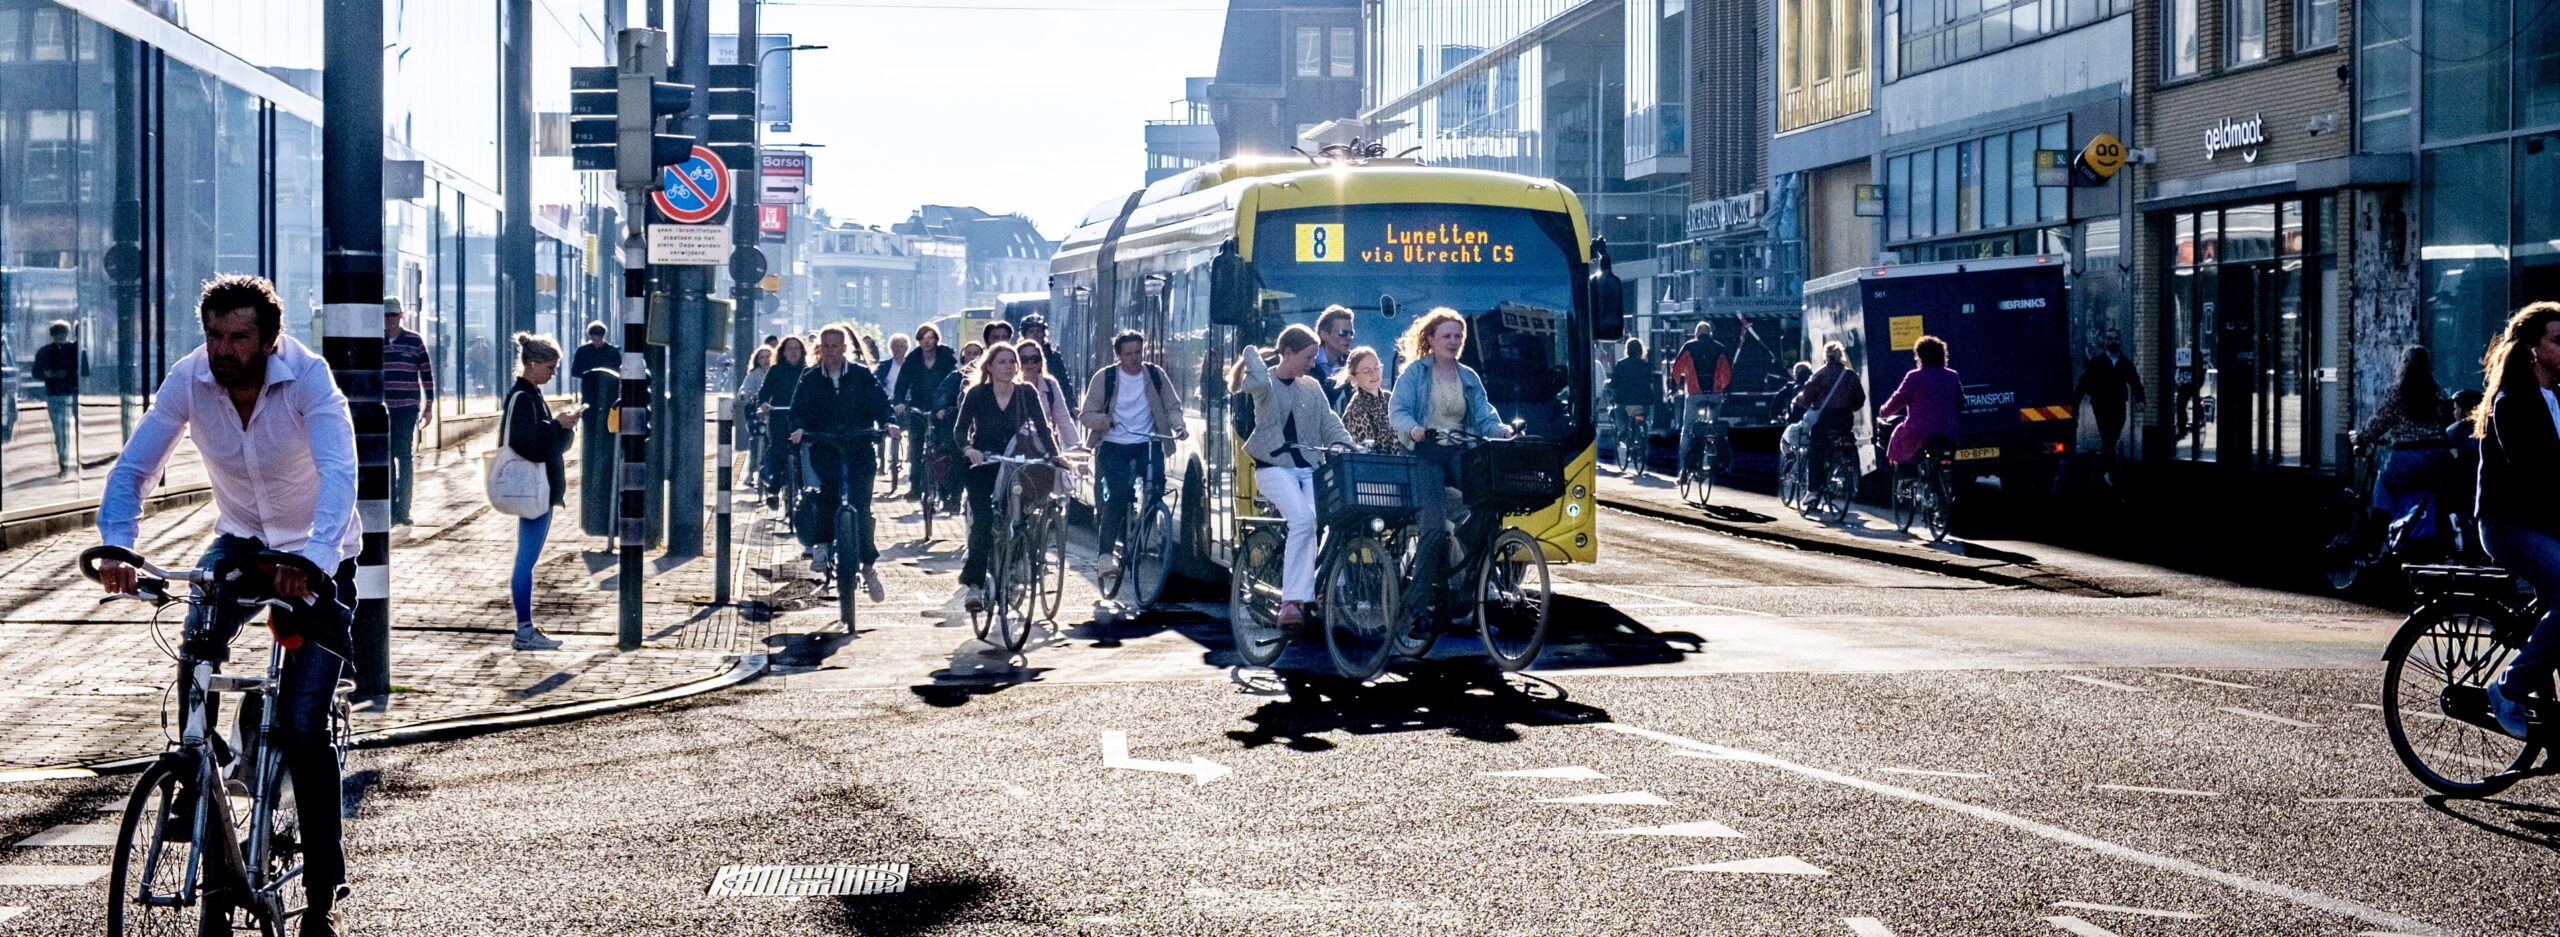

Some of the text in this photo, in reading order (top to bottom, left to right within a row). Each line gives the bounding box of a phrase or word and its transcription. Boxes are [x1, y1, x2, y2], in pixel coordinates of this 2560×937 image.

[2206, 112, 2264, 160] geldmaat
[1686, 199, 1749, 232] ARABIAN MUSK
[1313, 223, 1488, 259] 8 Lunetten
[1361, 245, 1514, 262] via Utrecht CS
[2006, 298, 2046, 310] BRINKS
[1966, 392, 2015, 406] TRANSPORT
